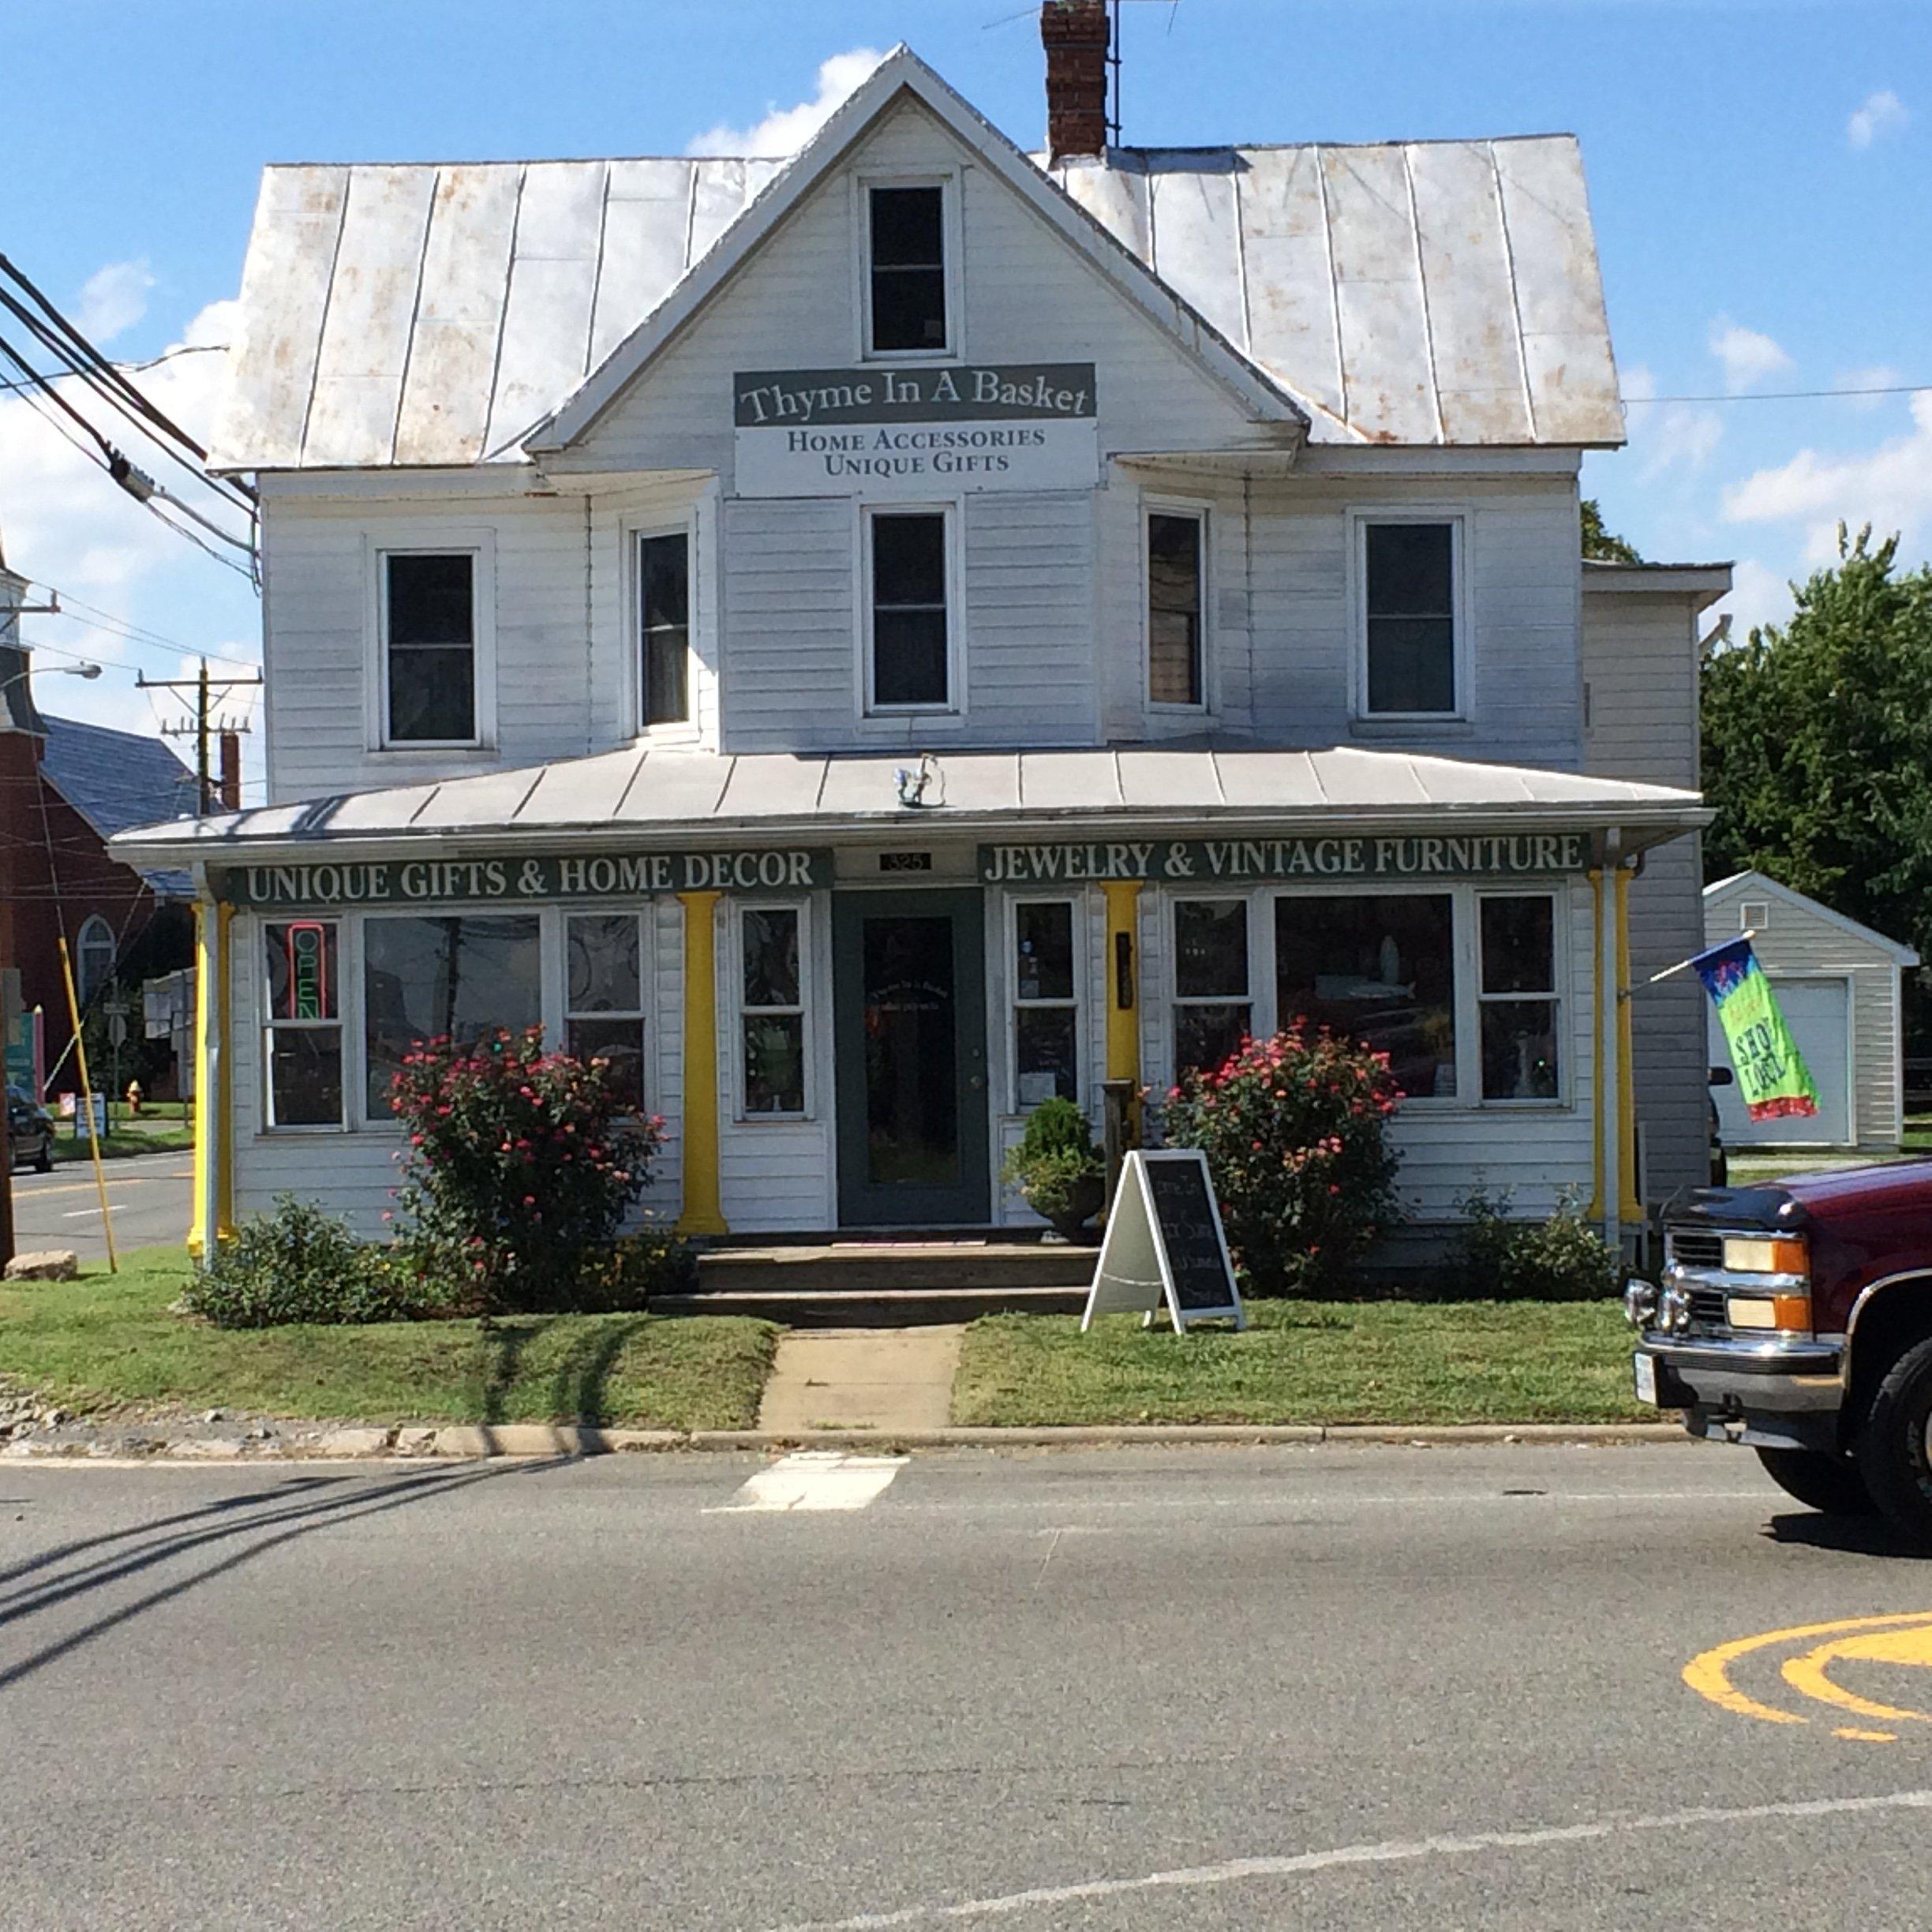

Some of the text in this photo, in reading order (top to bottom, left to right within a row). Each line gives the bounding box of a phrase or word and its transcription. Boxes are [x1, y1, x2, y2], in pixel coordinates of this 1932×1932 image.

[740, 371, 1088, 422] Thyme In A Basket
[788, 428, 1046, 452] HOME ACCESSORIES
[825, 451, 1009, 477] UNIQUE GIFTS
[248, 852, 814, 901] UNIQUE GIFTS & HOME DECOR
[985, 835, 1582, 881] JEWELRY & VINTAGE FURNITURE
[295, 930, 319, 1020] OPEN
